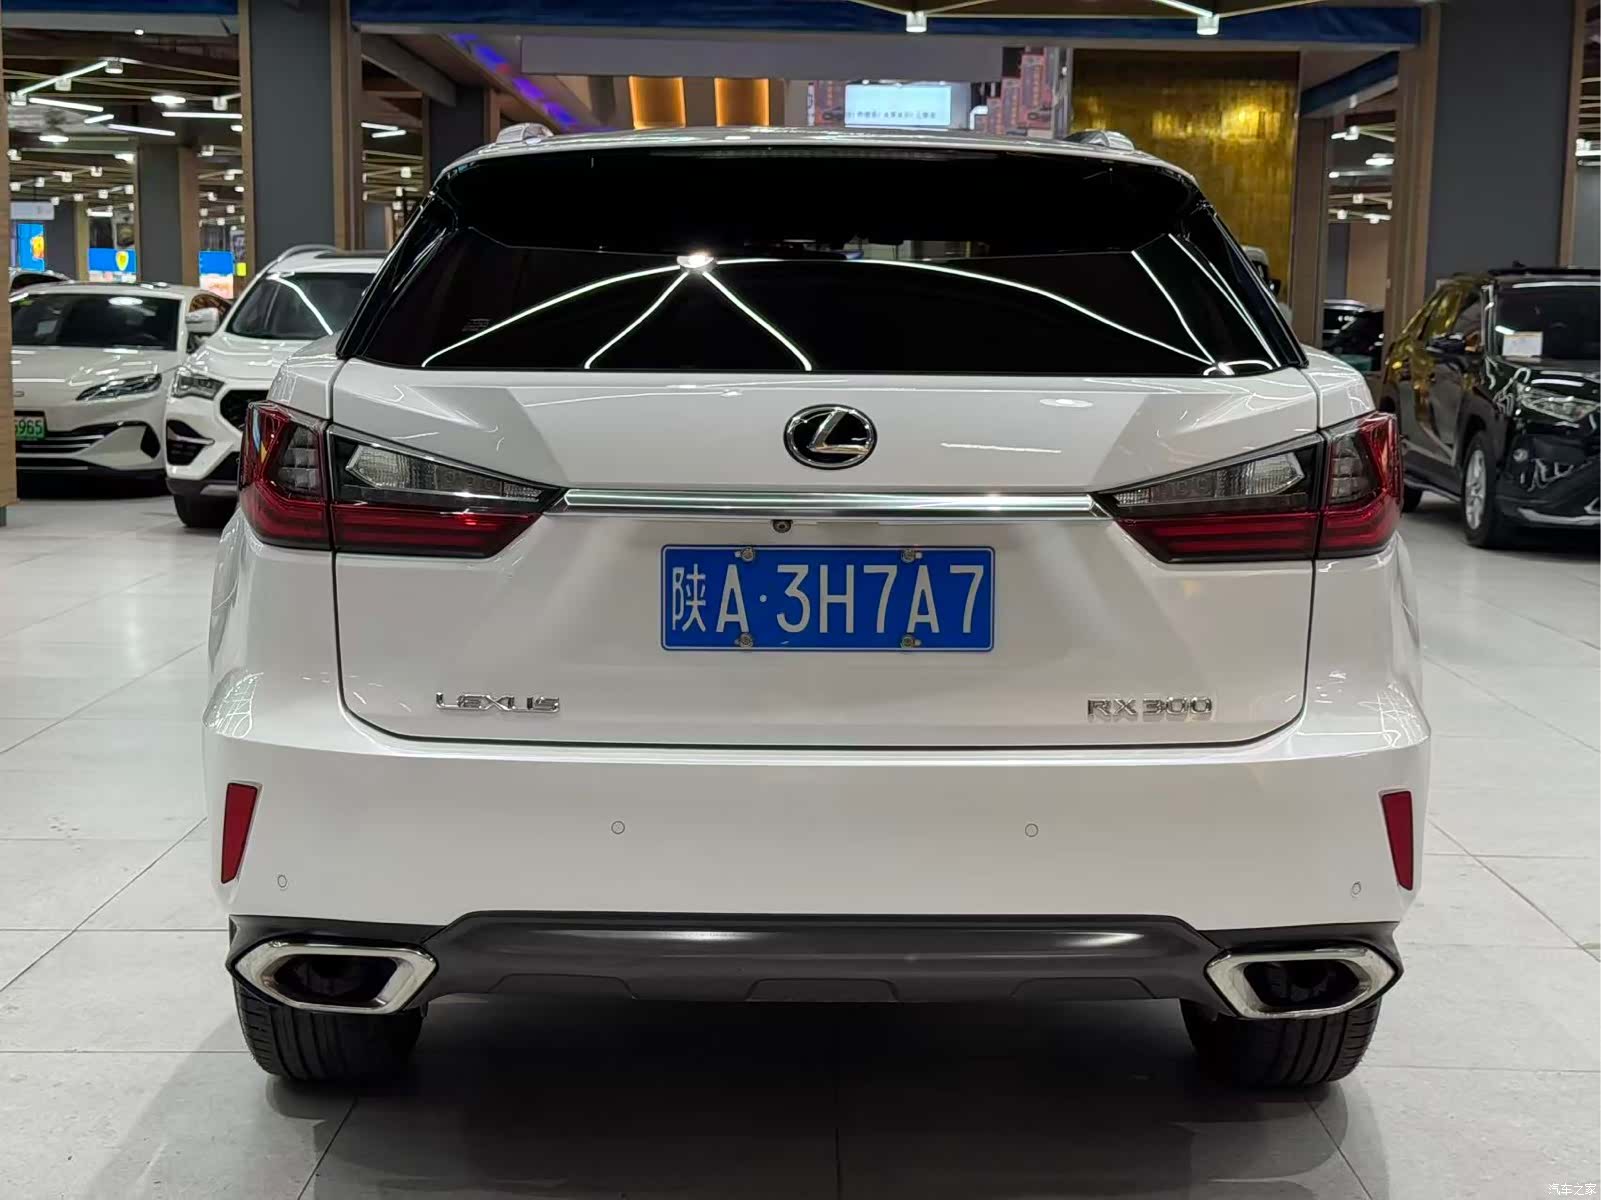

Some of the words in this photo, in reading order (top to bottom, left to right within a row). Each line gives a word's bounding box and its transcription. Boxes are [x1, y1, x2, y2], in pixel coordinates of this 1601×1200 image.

[435, 691, 560, 713] LEXUS
[1087, 698, 1137, 717] RX
[1142, 697, 1213, 717] 300
